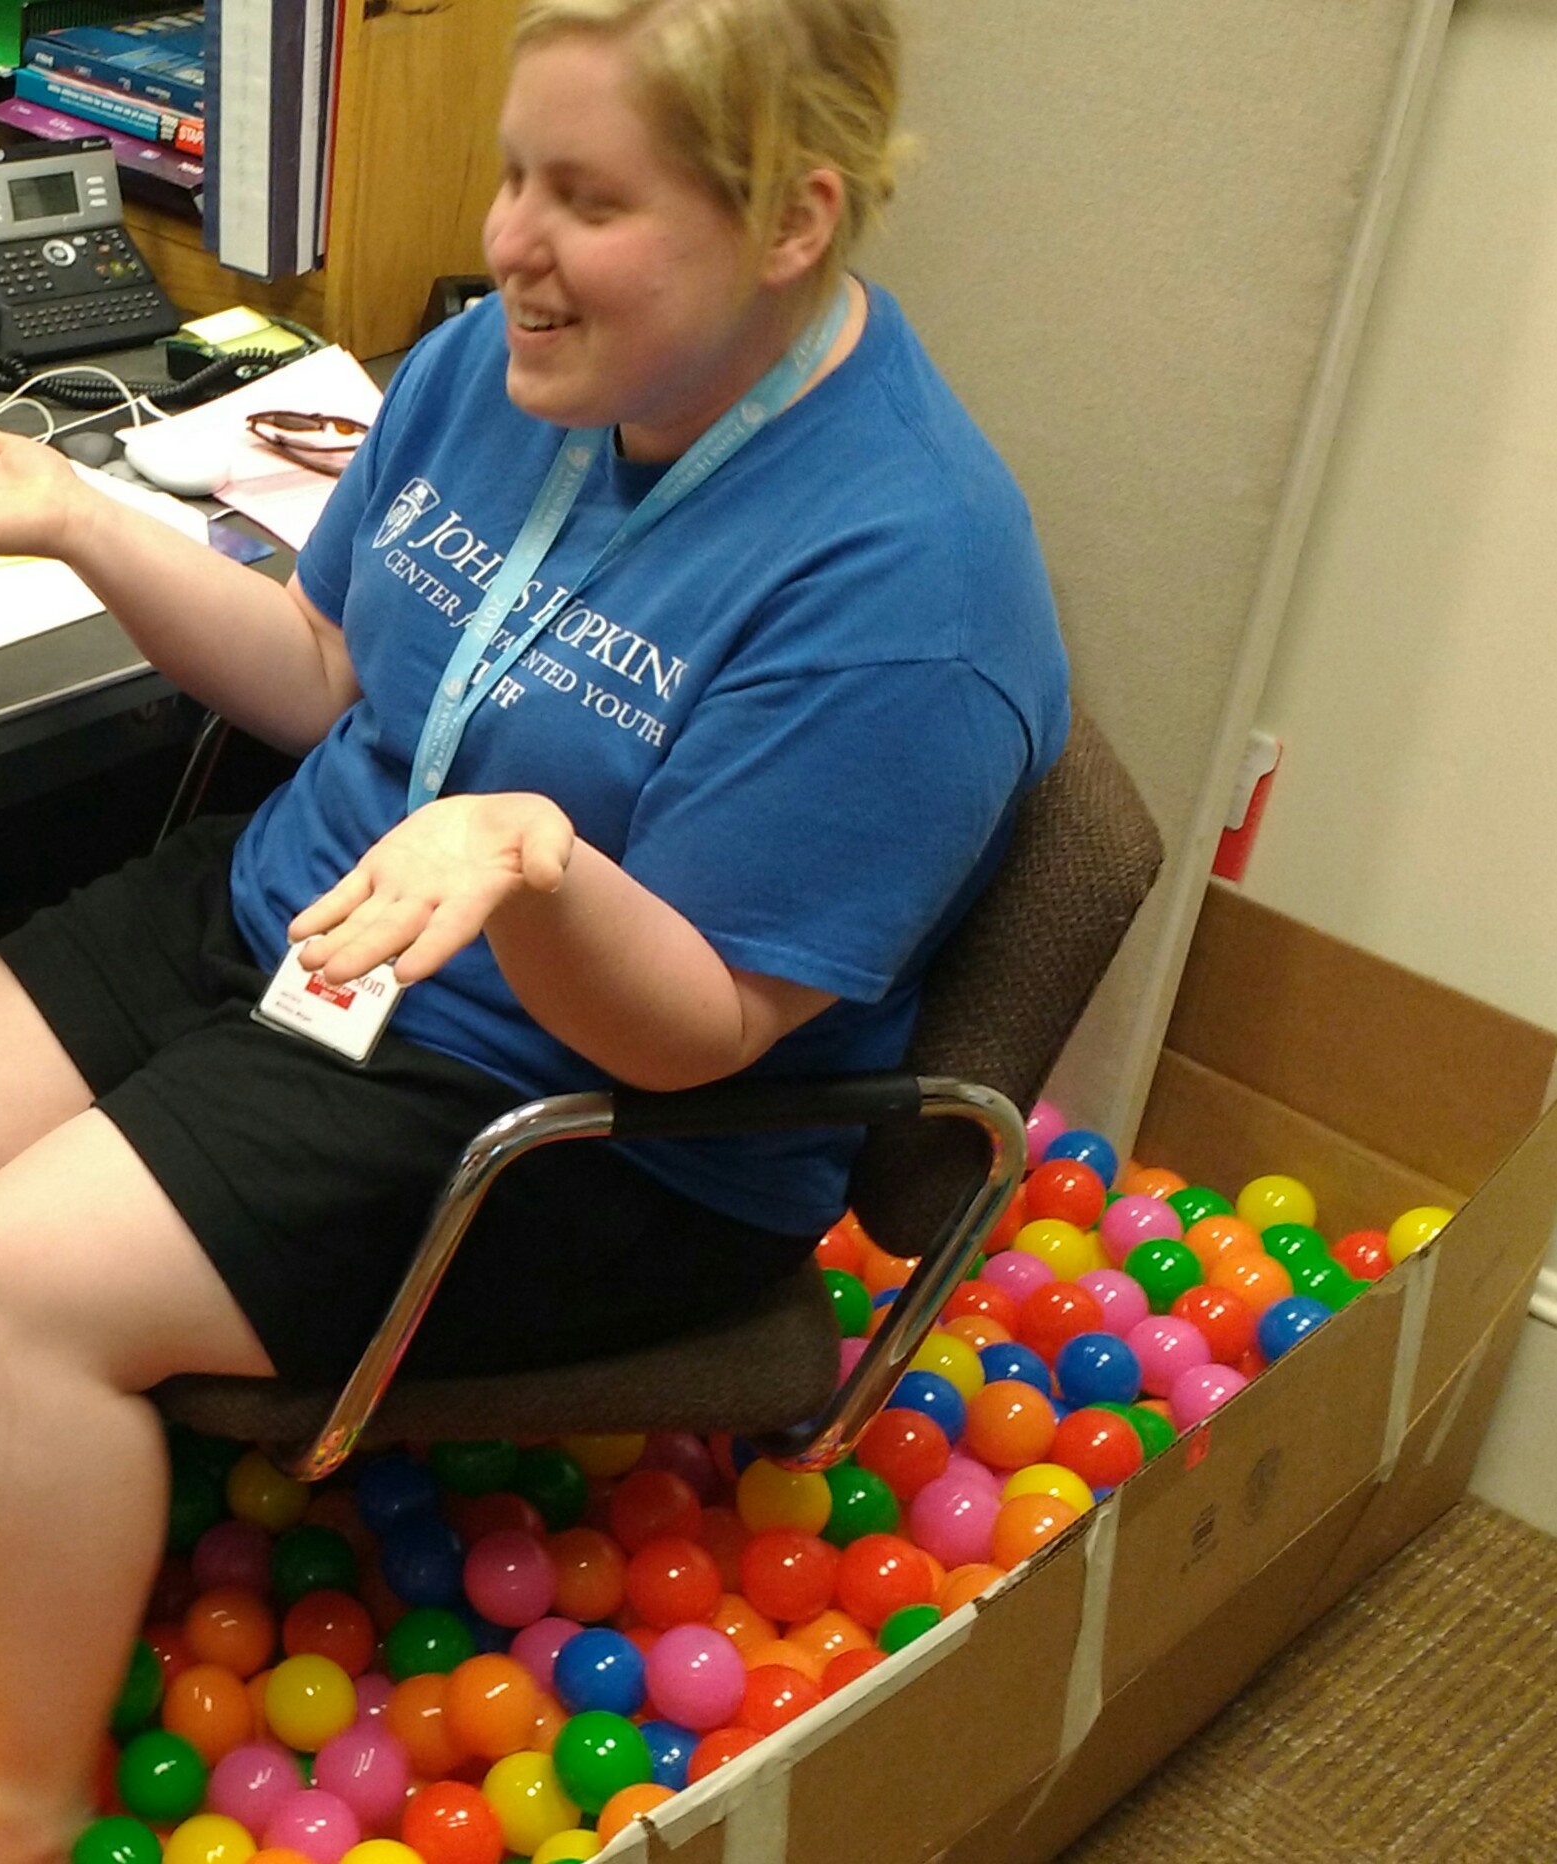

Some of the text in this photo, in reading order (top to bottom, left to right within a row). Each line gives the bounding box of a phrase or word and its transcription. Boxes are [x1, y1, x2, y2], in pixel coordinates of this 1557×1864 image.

[179, 126, 204, 146] STAP
[407, 511, 543, 613] JOHS
[384, 549, 462, 617] CENTER
[489, 629, 578, 693] TANTED
[580, 682, 667, 747] YOUTH
[470, 659, 526, 710] TFF
